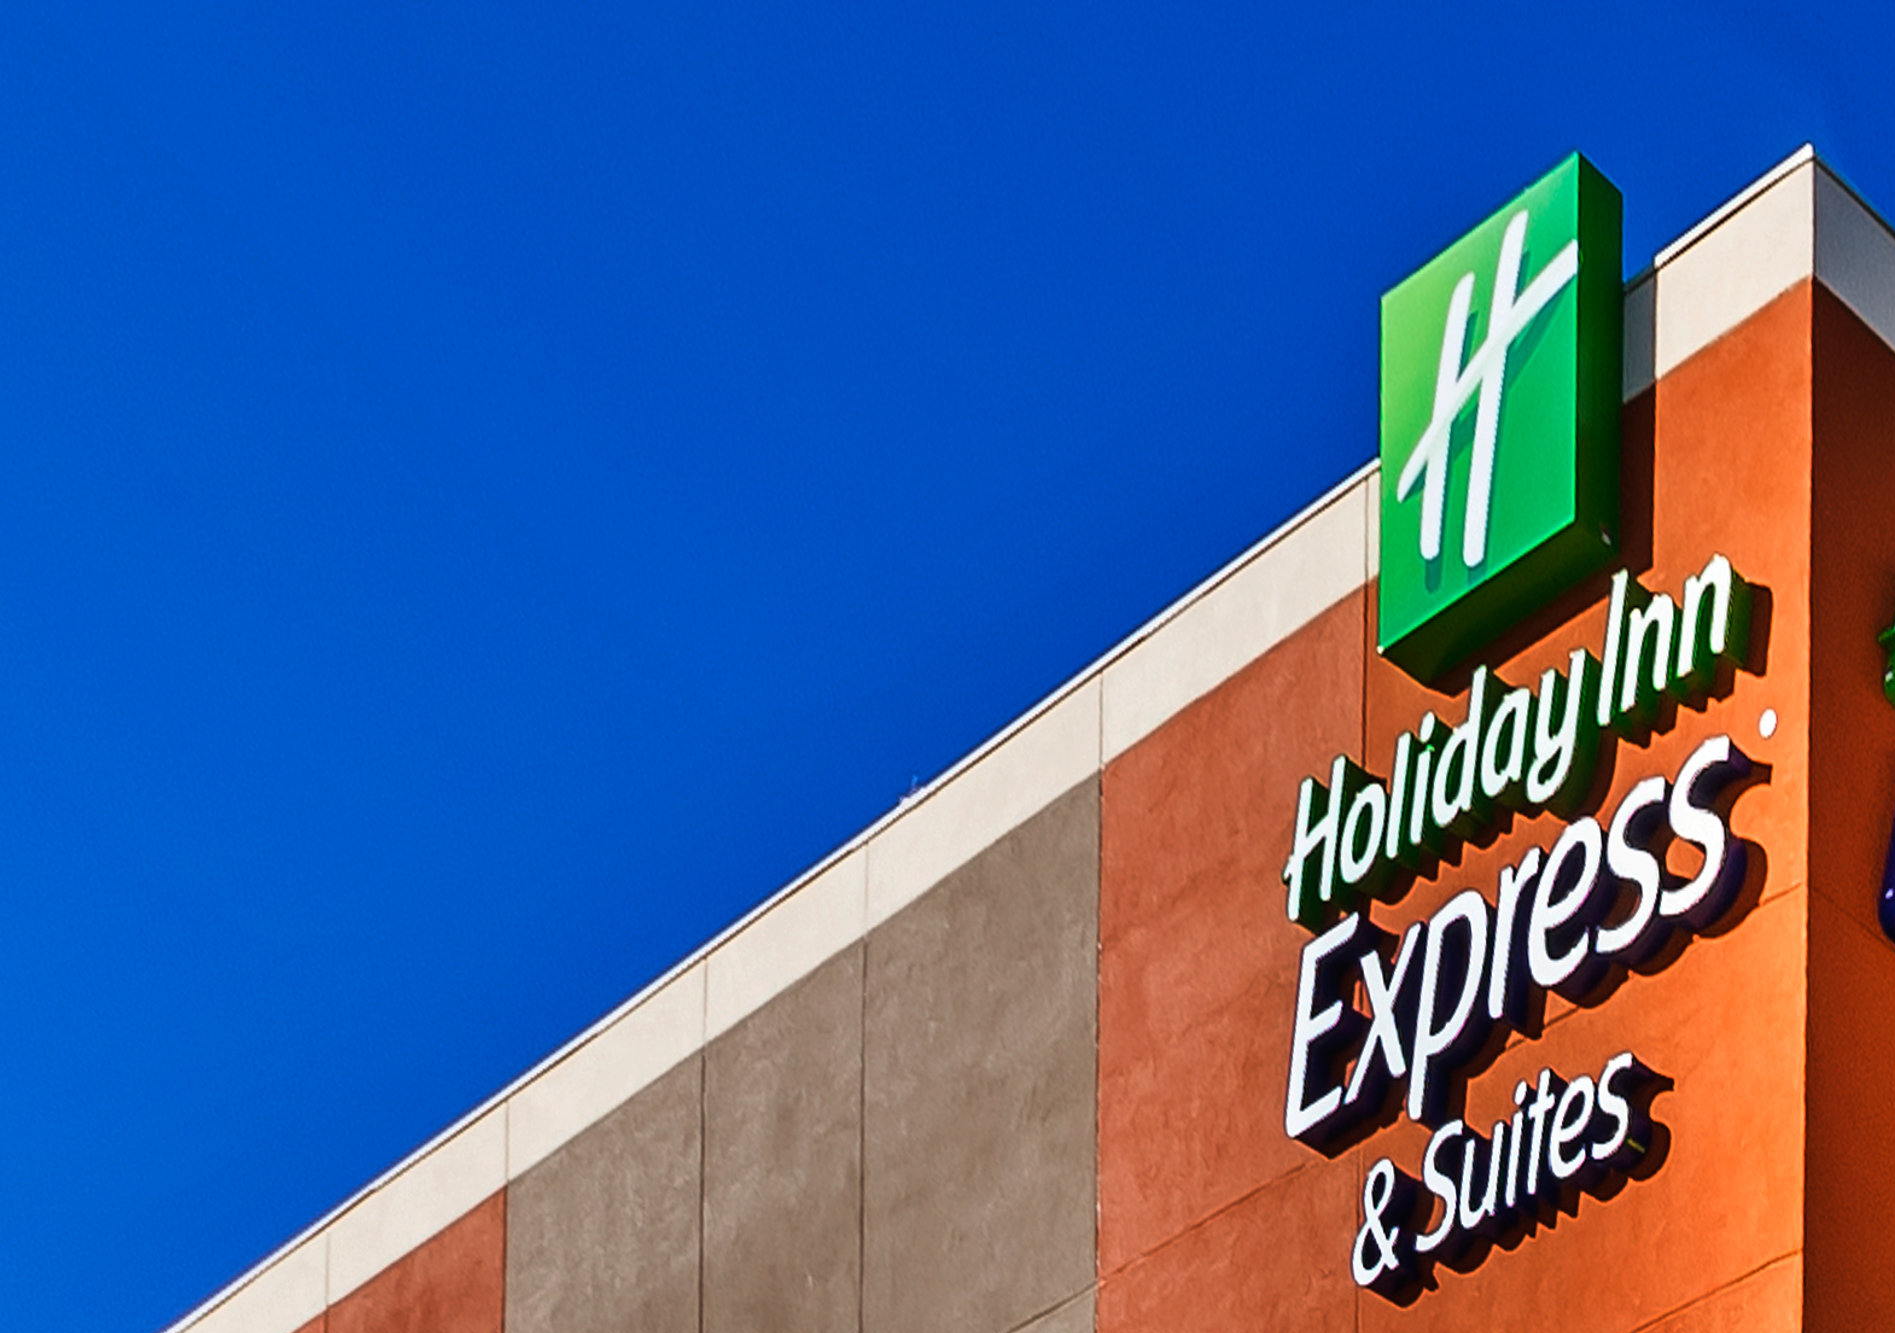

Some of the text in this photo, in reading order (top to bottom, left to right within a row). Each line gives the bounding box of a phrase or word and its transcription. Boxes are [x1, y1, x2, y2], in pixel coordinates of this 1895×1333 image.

[1284, 553, 1734, 922] Holiday Inn
[1284, 735, 1732, 1140] Express
[1350, 1050, 1632, 1289] & Suites
